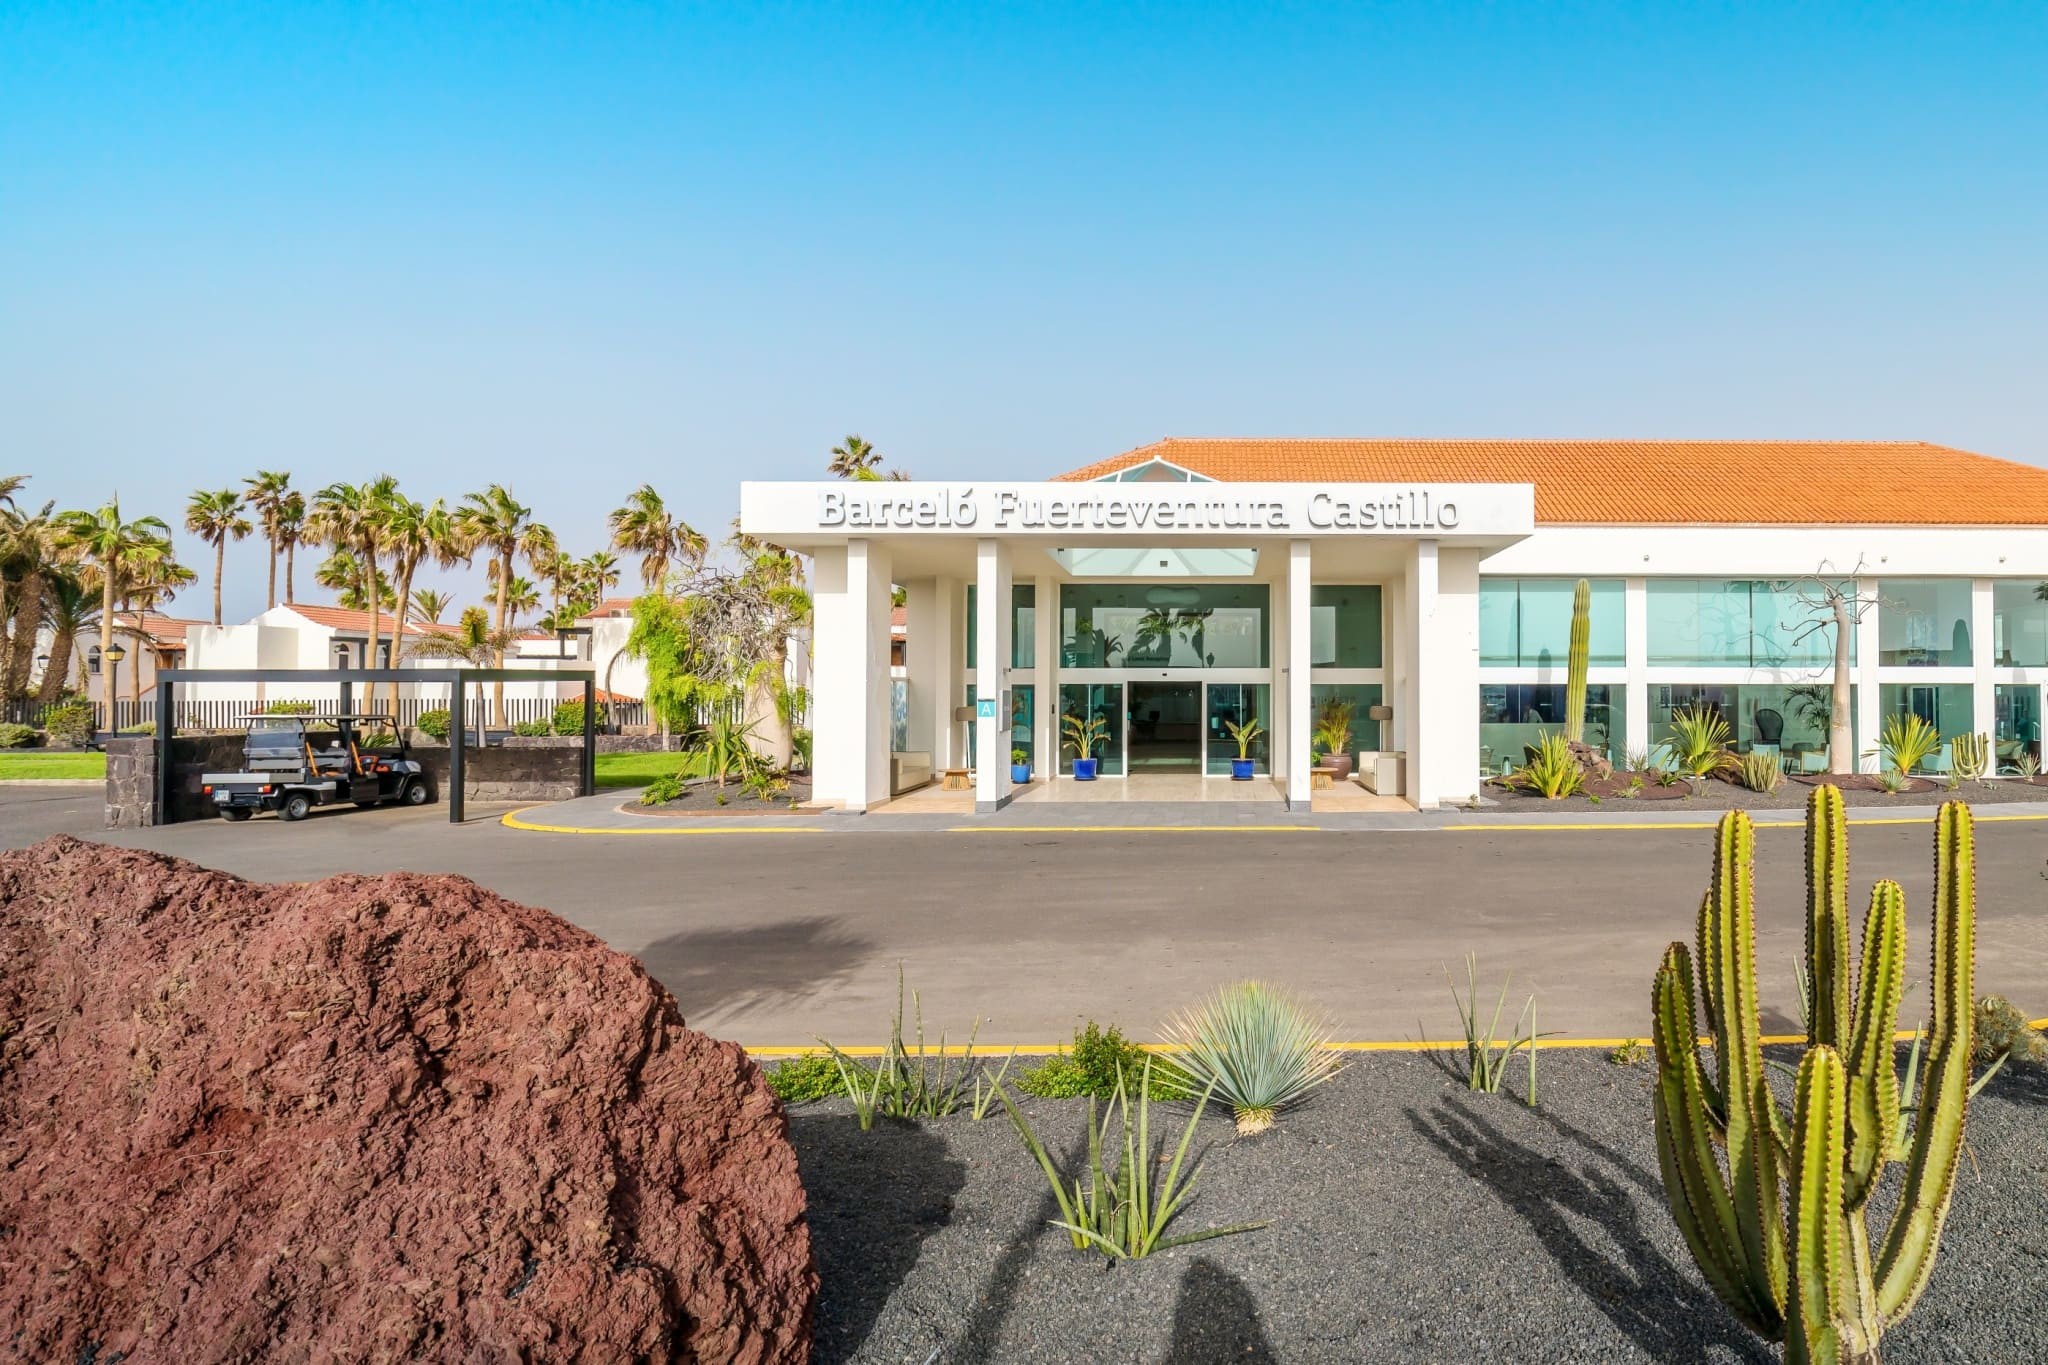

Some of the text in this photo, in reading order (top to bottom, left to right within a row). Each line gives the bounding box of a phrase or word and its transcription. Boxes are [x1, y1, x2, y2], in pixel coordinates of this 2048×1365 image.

[818, 487, 1460, 529] Barceló Fuerteventura Castillo
[981, 703, 992, 716] A
